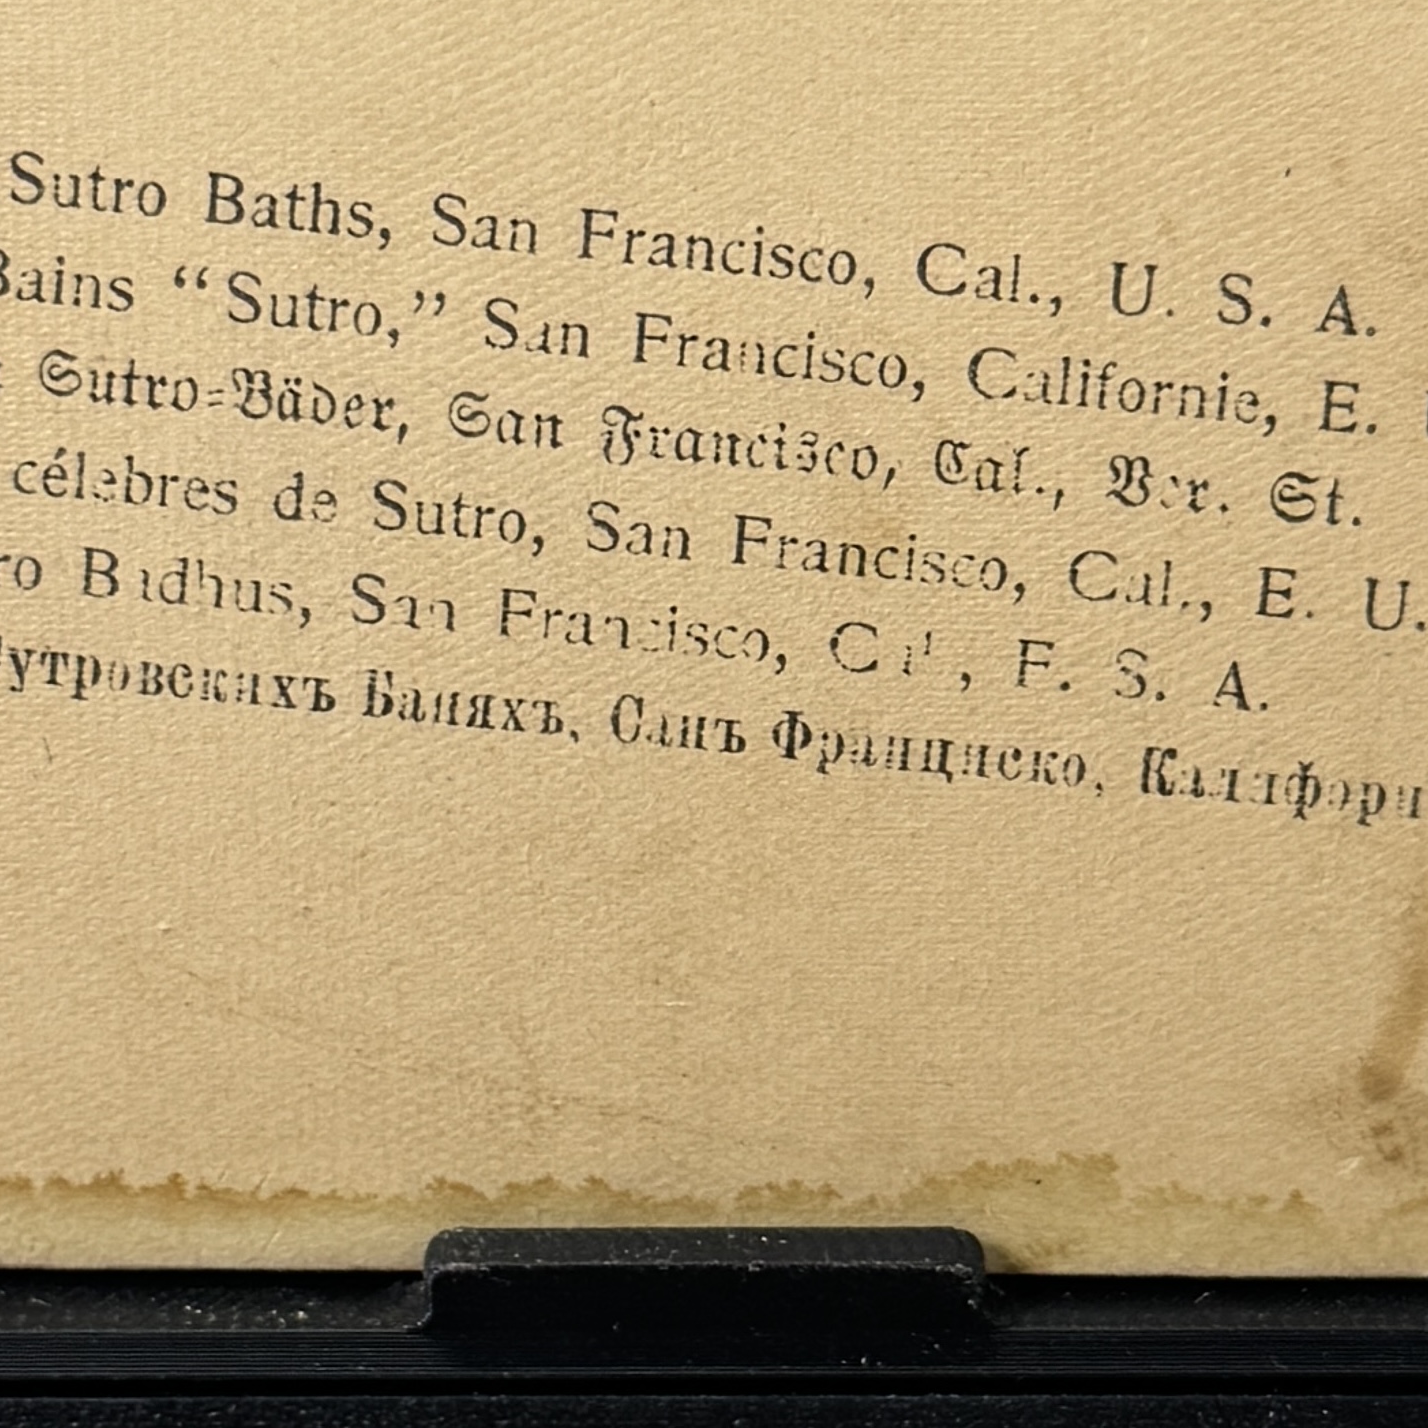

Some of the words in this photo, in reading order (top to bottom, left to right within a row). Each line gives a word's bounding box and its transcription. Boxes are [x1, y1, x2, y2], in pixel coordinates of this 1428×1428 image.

[9, 150, 168, 217] Sutro
[204, 170, 392, 251] Baths,
[432, 192, 538, 255] San
[577, 207, 875, 300] Francisco,
[916, 242, 1063, 318] Cal.,
[1111, 261, 1175, 318] U.
[1217, 272, 1272, 328] S.
[1314, 284, 1377, 337] A.
[484, 296, 590, 359] San
[632, 311, 925, 403] Francisco,
[967, 346, 1278, 438] Californie,
[1317, 379, 1378, 435] E.
[447, 390, 564, 450] San
[600, 404, 896, 491] Francisco,
[934, 438, 1065, 512] Cal.,
[1269, 471, 1362, 527] St.
[12, 446, 238, 516] célebres
[272, 470, 338, 523] de
[373, 478, 545, 558] Sutro,
[586, 499, 692, 561] San
[731, 513, 1027, 606] Francisco,
[1068, 549, 1213, 623] Cal.,
[1255, 566, 1315, 619] E.
[1365, 576, 1427, 633] U.
[1015, 638, 1071, 692] F.
[1114, 647, 1166, 702] S.
[1212, 660, 1269, 712] A.
